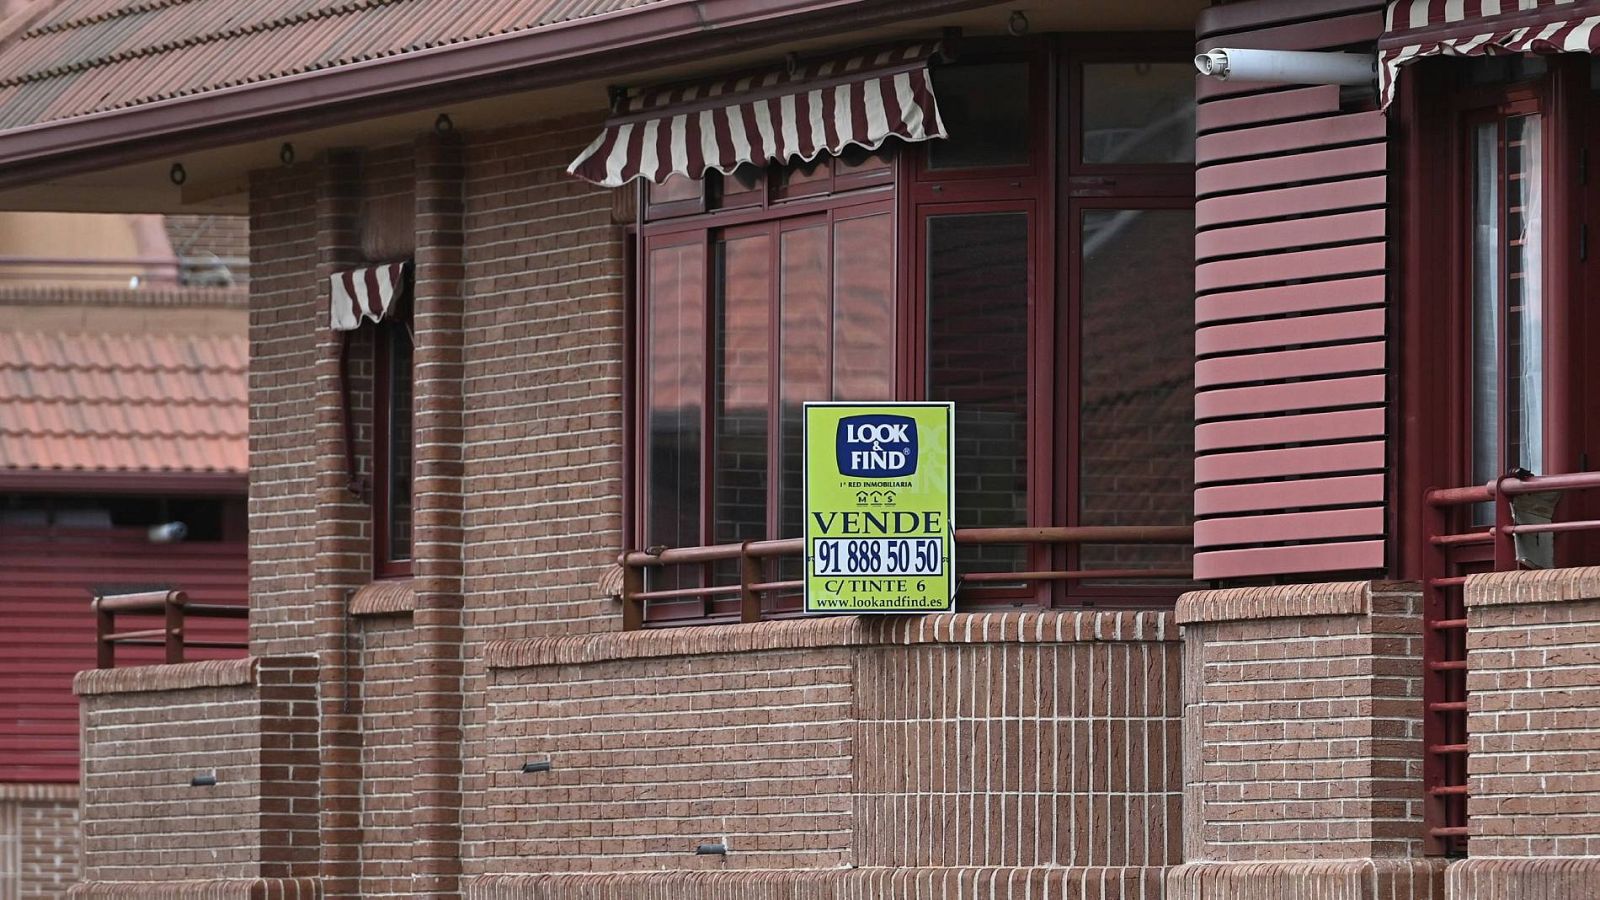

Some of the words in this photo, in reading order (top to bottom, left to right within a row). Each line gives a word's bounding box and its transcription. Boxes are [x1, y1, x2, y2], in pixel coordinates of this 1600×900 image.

[846, 424, 910, 443] LOOK
[872, 440, 884, 451] &
[812, 511, 942, 534] VENDE
[819, 540, 842, 574] 91
[847, 540, 882, 573] 888
[887, 540, 910, 573] 50
[915, 540, 938, 573] 50
[825, 580, 845, 595] C/
[848, 580, 907, 592] TINTE
[916, 580, 926, 592] 6
[817, 596, 942, 607] www.lookandfind.es
